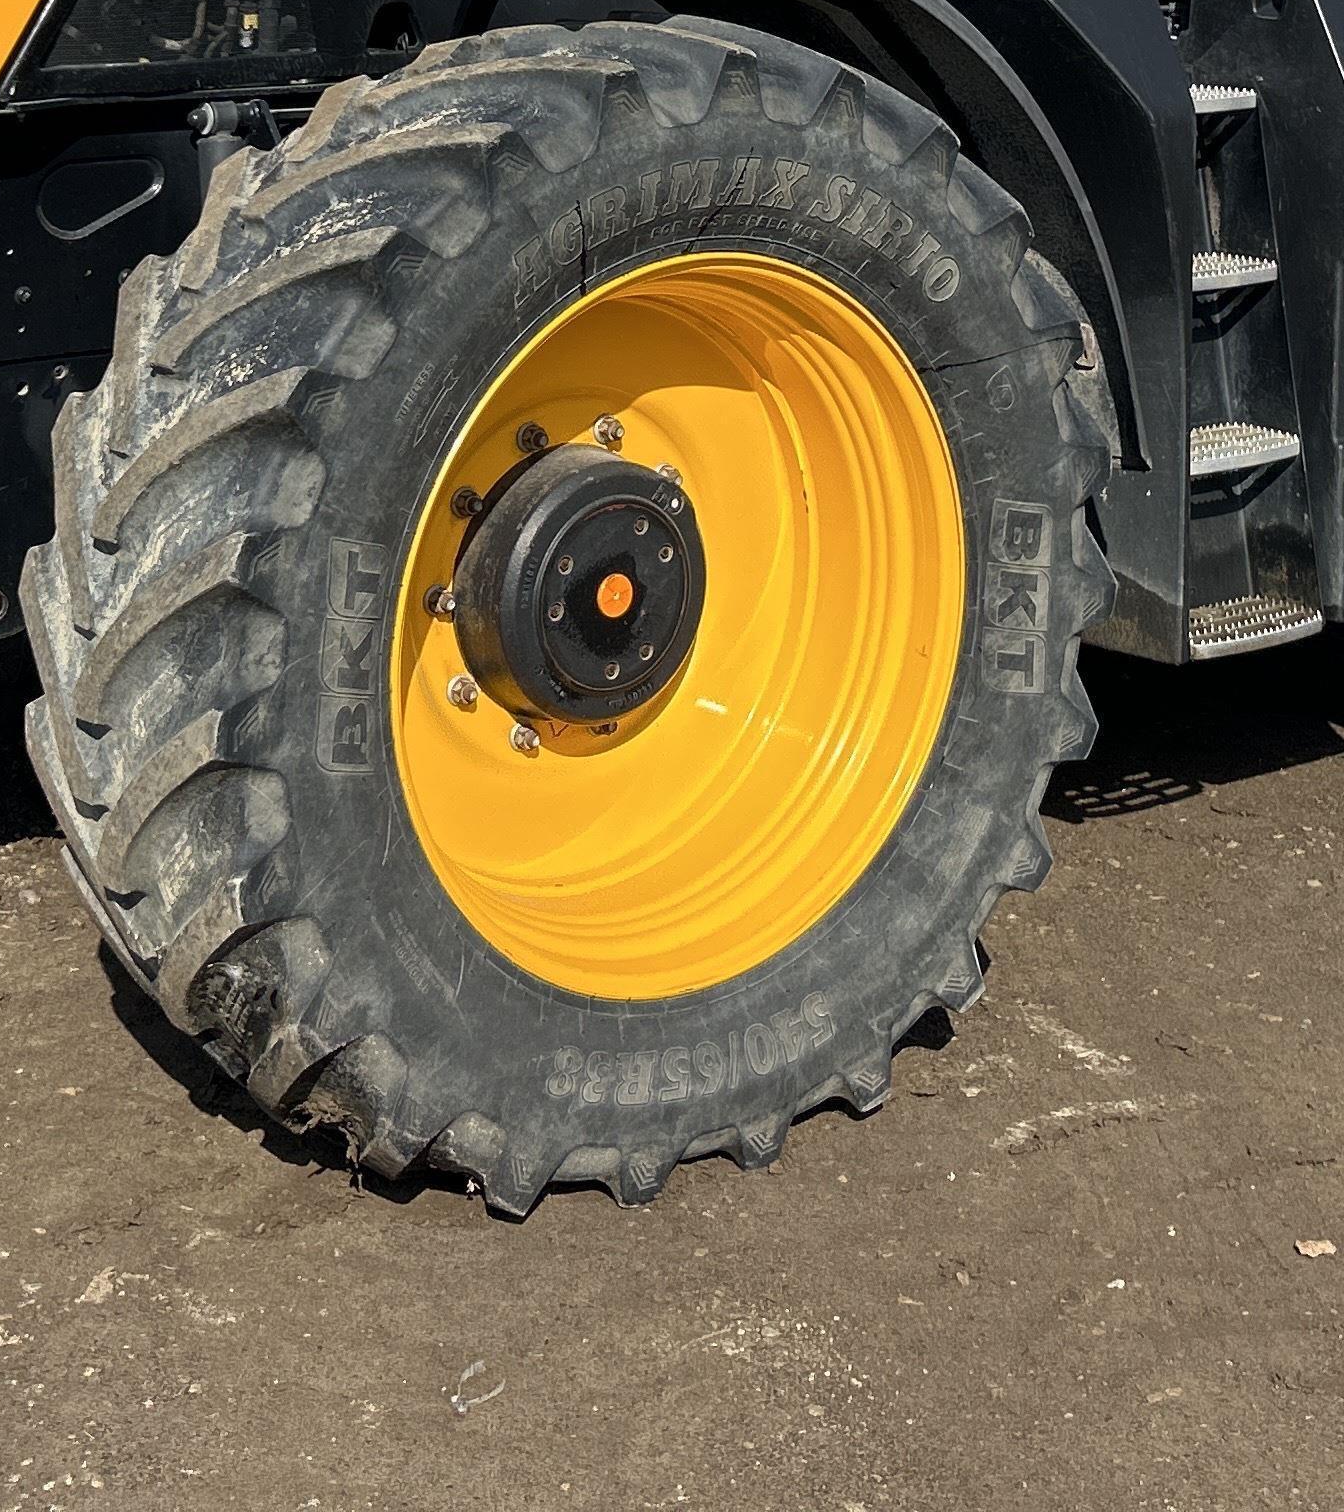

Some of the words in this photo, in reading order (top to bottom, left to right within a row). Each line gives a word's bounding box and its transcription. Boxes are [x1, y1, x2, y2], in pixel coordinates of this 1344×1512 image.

[512, 155, 811, 310] AGRIMAX
[807, 175, 961, 303] SIRIO
[328, 547, 383, 767] BKT
[993, 507, 1045, 689] BKT
[545, 990, 835, 1106] 540/65R38
